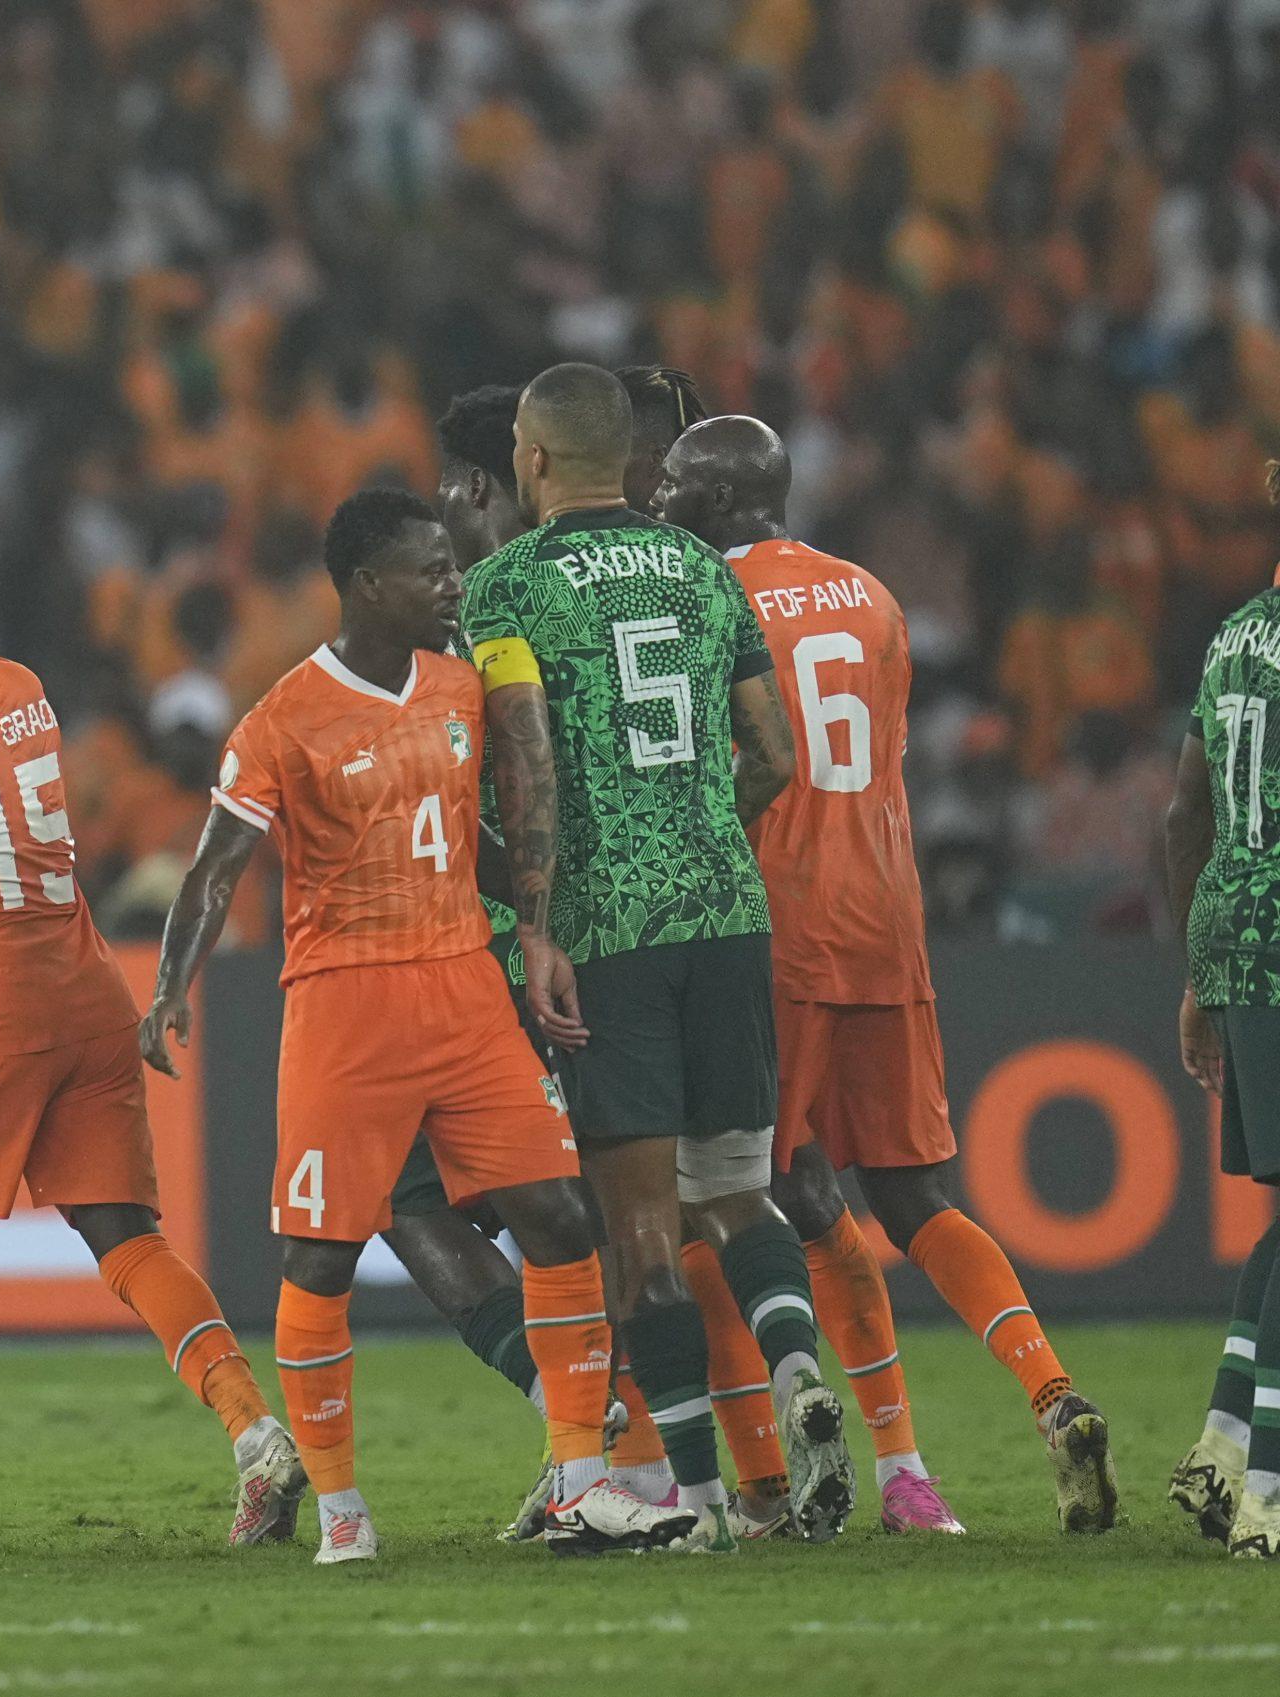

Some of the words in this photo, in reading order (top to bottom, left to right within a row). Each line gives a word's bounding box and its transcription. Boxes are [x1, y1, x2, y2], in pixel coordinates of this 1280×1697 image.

[555, 545, 685, 590] EKONG
[753, 577, 873, 622] FOFANA
[612, 615, 696, 769] 5
[792, 631, 872, 793] 6
[341, 757, 374, 778] PUMA
[1216, 693, 1267, 849] 11
[412, 794, 449, 873] 4
[288, 1149, 326, 1229] 4
[568, 1360, 611, 1374] PUMA
[302, 1404, 344, 1422] PUMA
